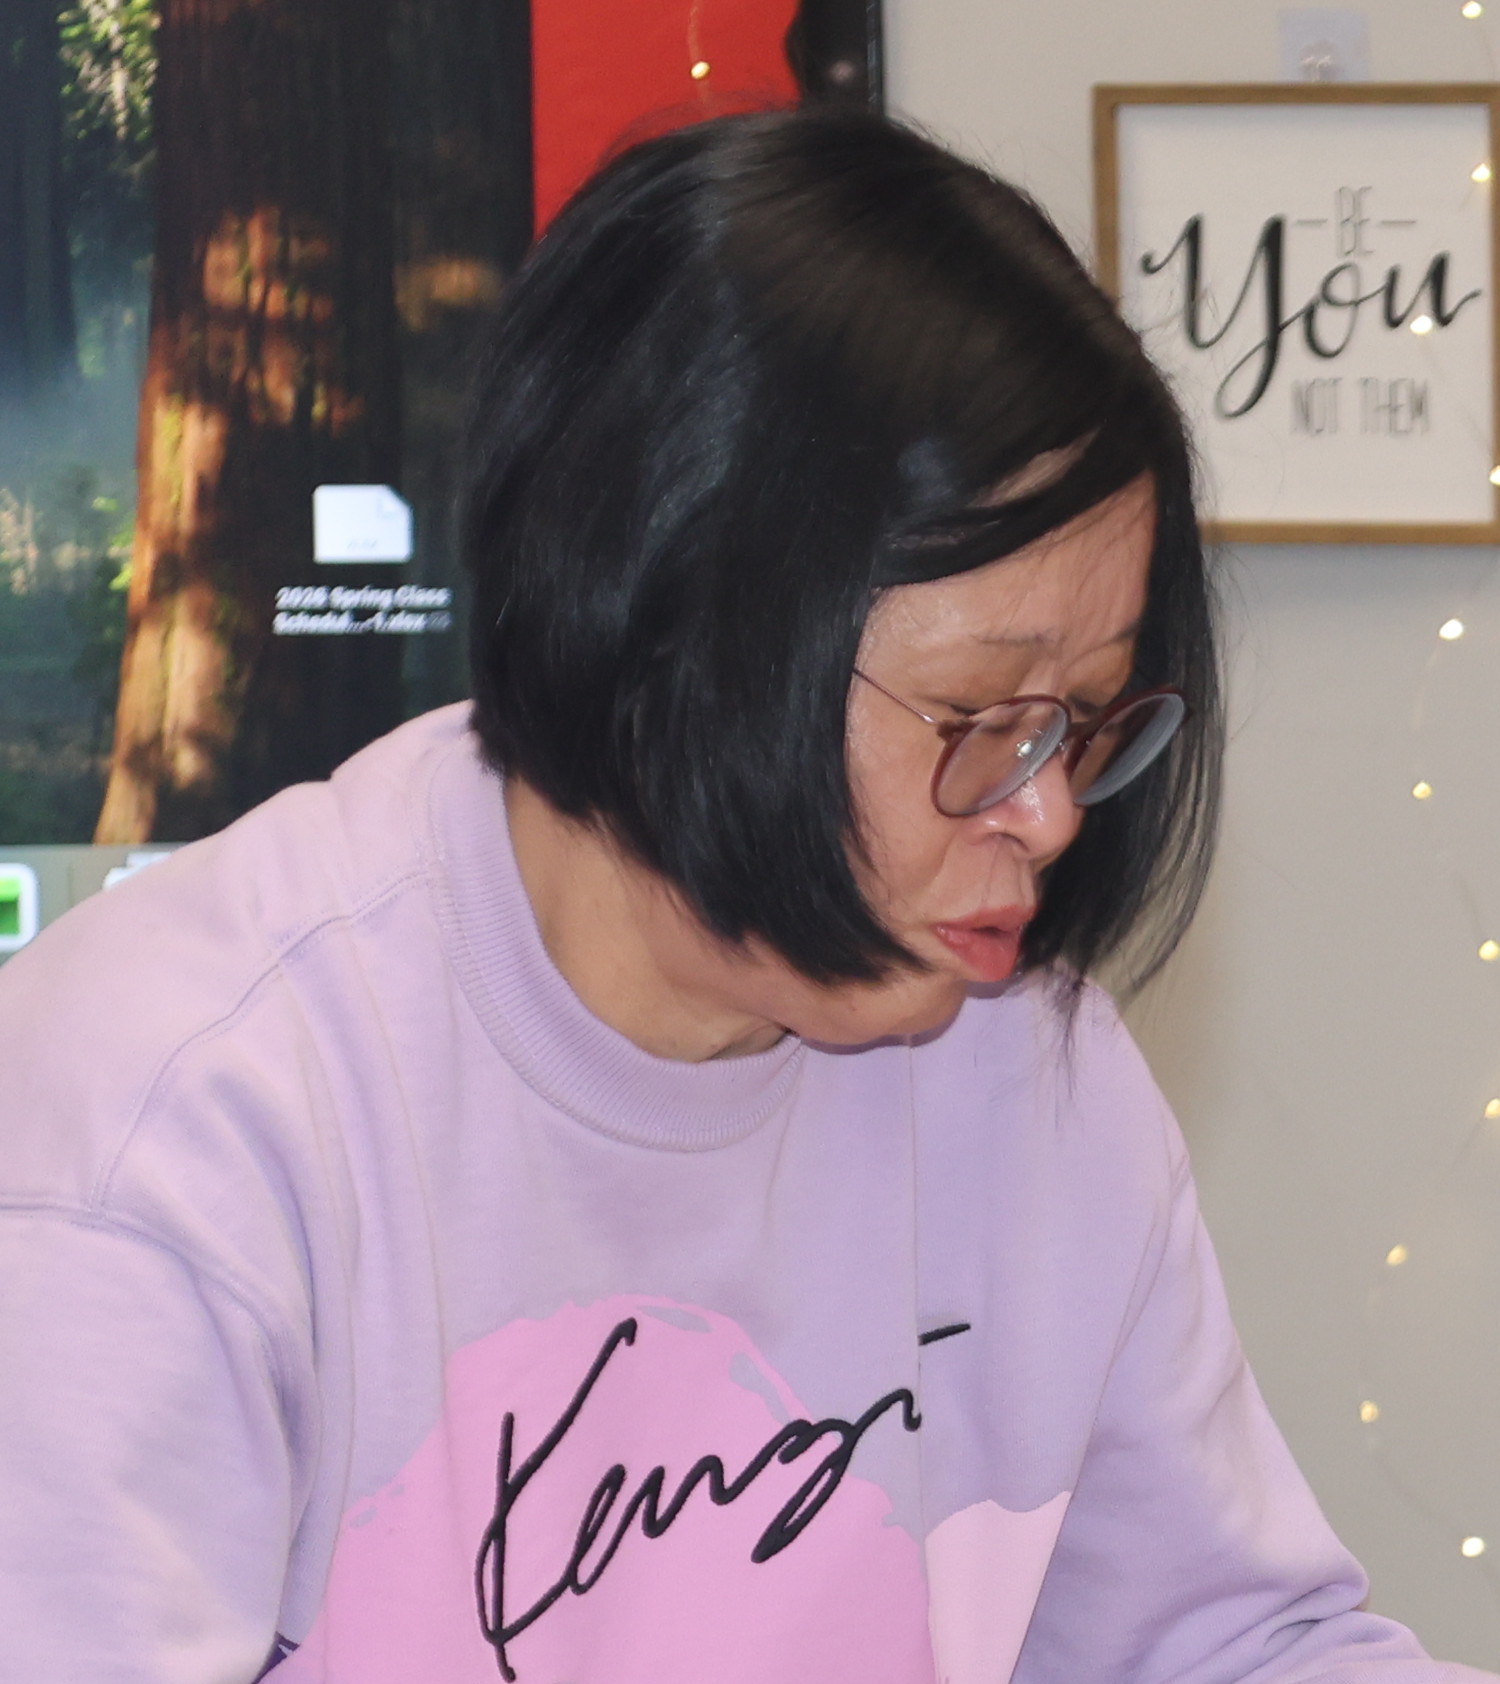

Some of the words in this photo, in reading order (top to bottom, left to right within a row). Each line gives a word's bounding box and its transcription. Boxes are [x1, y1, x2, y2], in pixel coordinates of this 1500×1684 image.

[1336, 185, 1374, 258] BE
[1139, 212, 1483, 419] You
[1290, 376, 1342, 438] NOT
[1357, 376, 1430, 438] THEM
